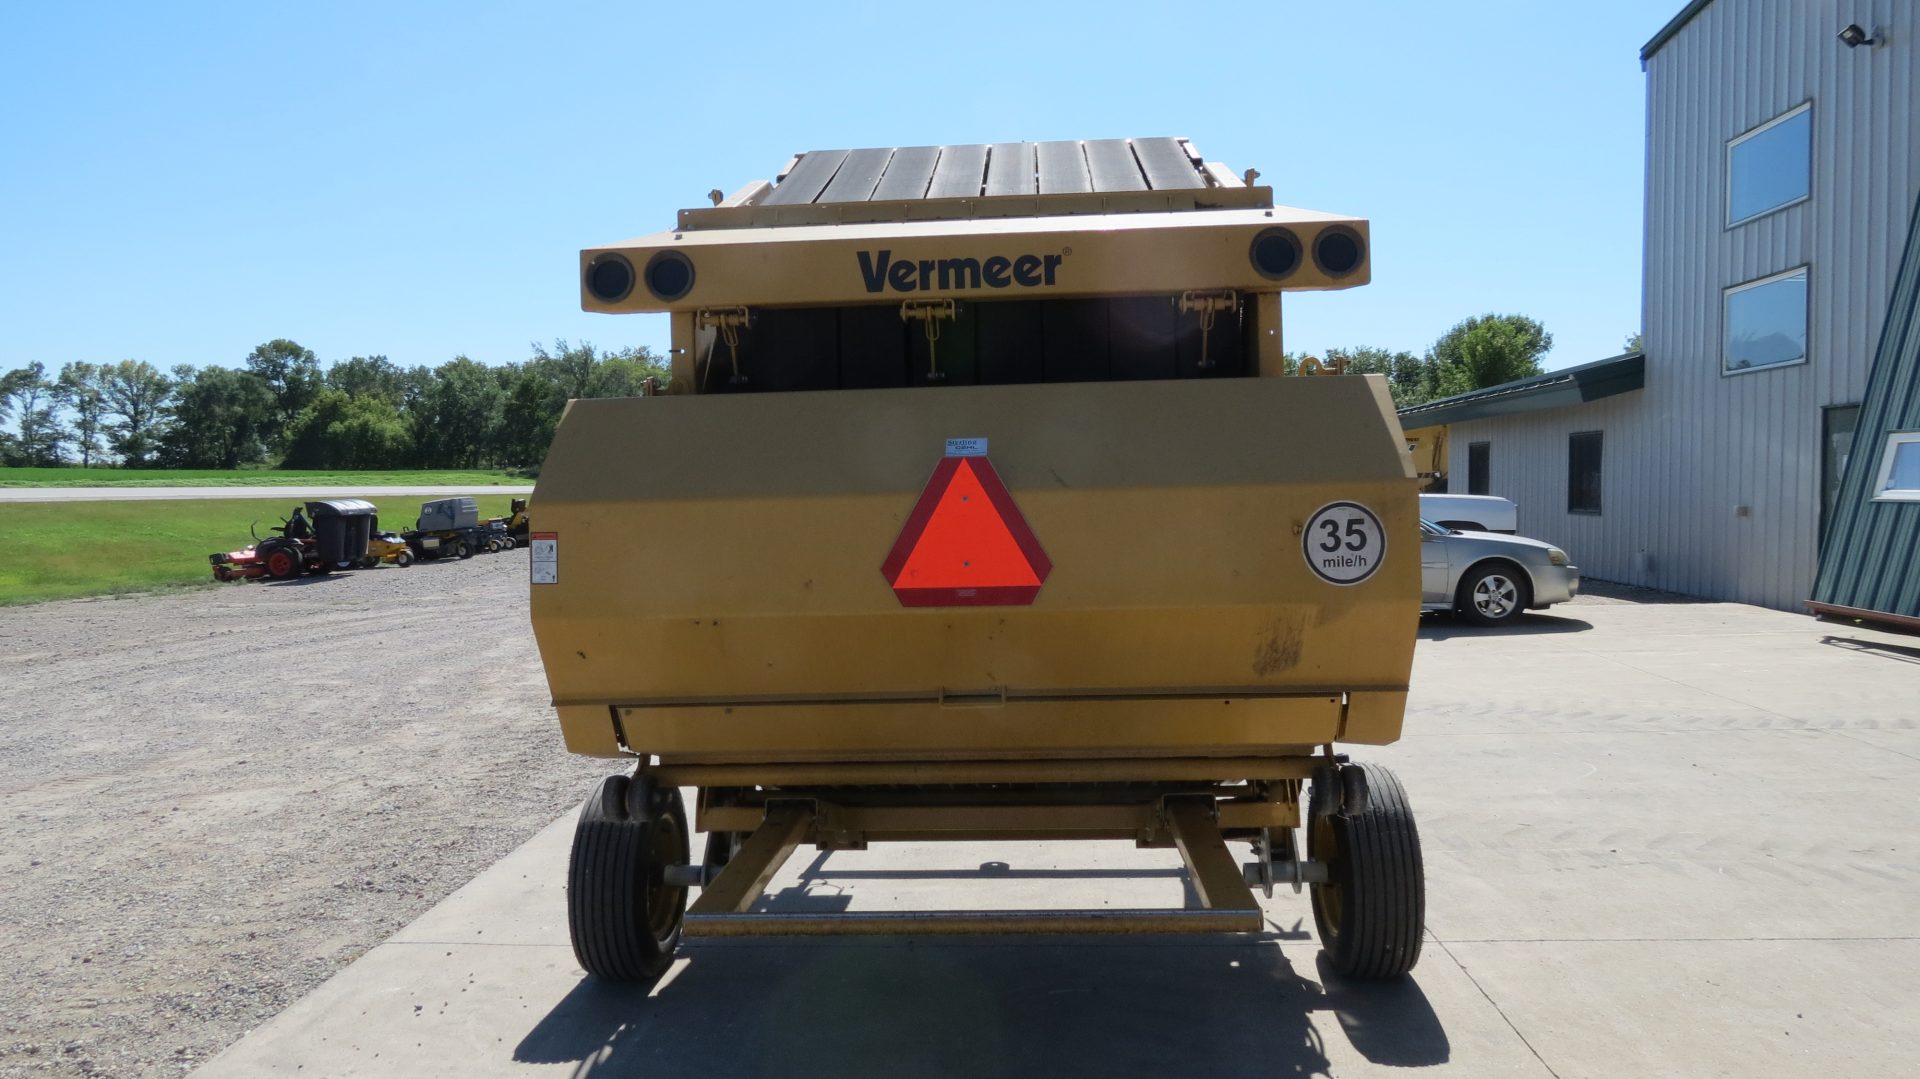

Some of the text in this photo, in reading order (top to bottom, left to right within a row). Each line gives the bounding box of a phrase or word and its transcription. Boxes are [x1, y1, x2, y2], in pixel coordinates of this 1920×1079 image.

[856, 250, 1062, 293] Vermeer
[1320, 518, 1367, 552] 35
[1323, 555, 1367, 568] mile/h
